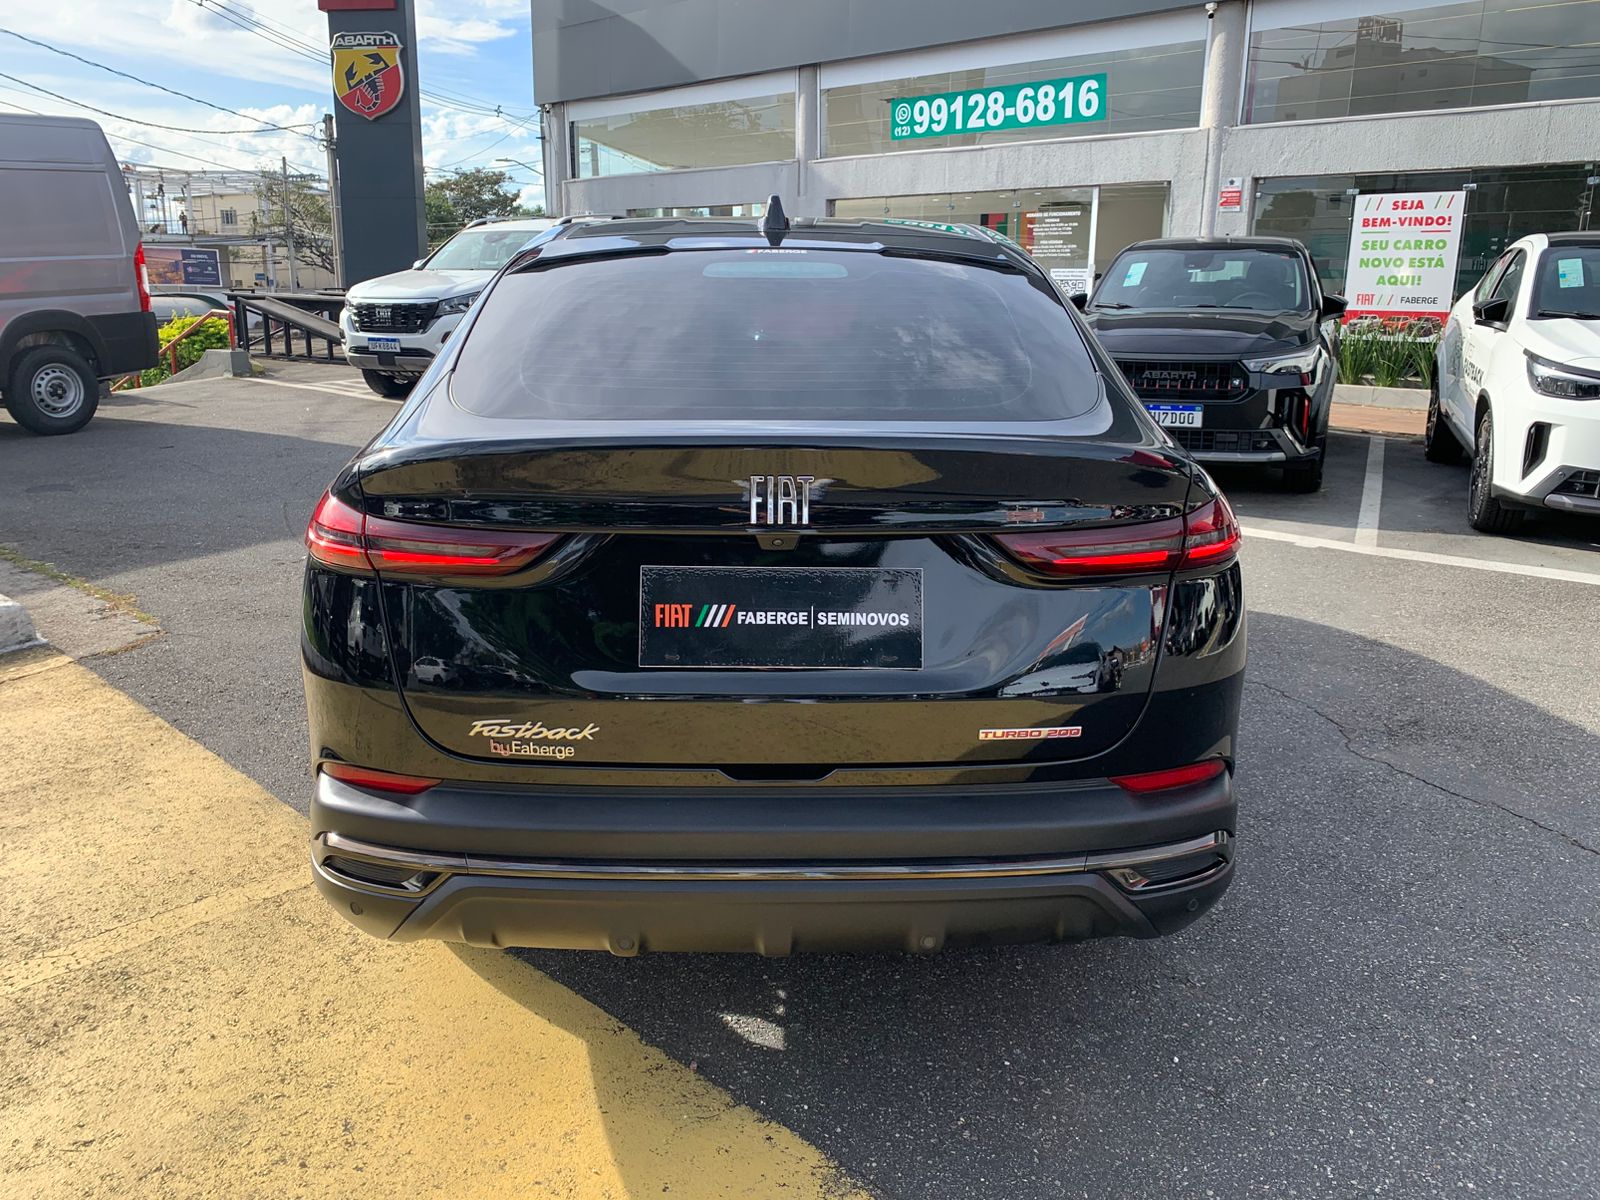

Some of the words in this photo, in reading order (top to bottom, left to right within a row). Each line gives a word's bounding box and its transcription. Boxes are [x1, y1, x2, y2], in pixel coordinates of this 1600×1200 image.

[335, 34, 394, 46] ABARTH
[894, 126, 911, 137] (12)
[913, 79, 1100, 134] 99128-6816
[1391, 199, 1425, 210] SEJA
[1361, 215, 1452, 227] BEM-VINDO!
[1361, 240, 1389, 251] SEU
[1393, 239, 1448, 250] CARRO
[1359, 257, 1403, 269] NOVO
[1408, 253, 1445, 269] ESTÁ
[1376, 275, 1422, 286] AQUI!
[1356, 293, 1376, 305] FIAT
[1400, 296, 1438, 304] FABERGE
[1142, 370, 1197, 380] ABARTH
[750, 475, 815, 525] FIAT
[655, 604, 693, 628] FIAT
[737, 611, 808, 625] FABERGE
[817, 612, 910, 627] SEMINOVOS
[468, 719, 601, 740] Fastback
[980, 730, 1042, 739] TURBO
[1047, 728, 1081, 738] 200
